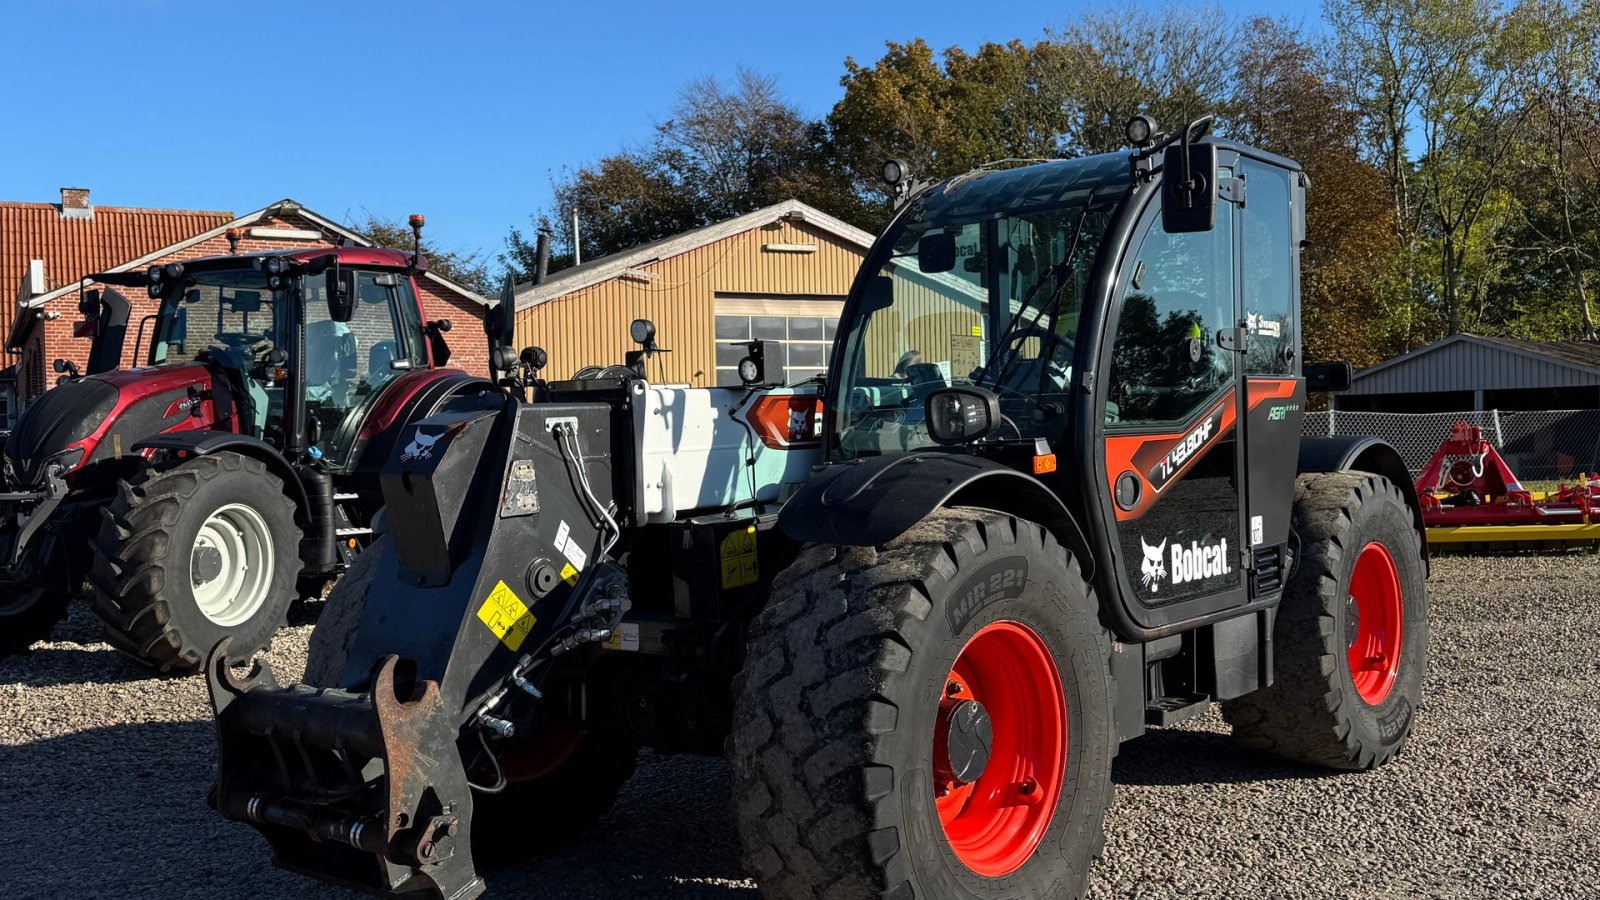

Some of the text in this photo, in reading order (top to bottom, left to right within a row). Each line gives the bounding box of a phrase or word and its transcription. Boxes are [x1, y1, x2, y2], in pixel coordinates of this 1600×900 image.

[1171, 538, 1228, 585] Bobcat
[952, 581, 986, 626] MIR
[989, 569, 1024, 593] 221
